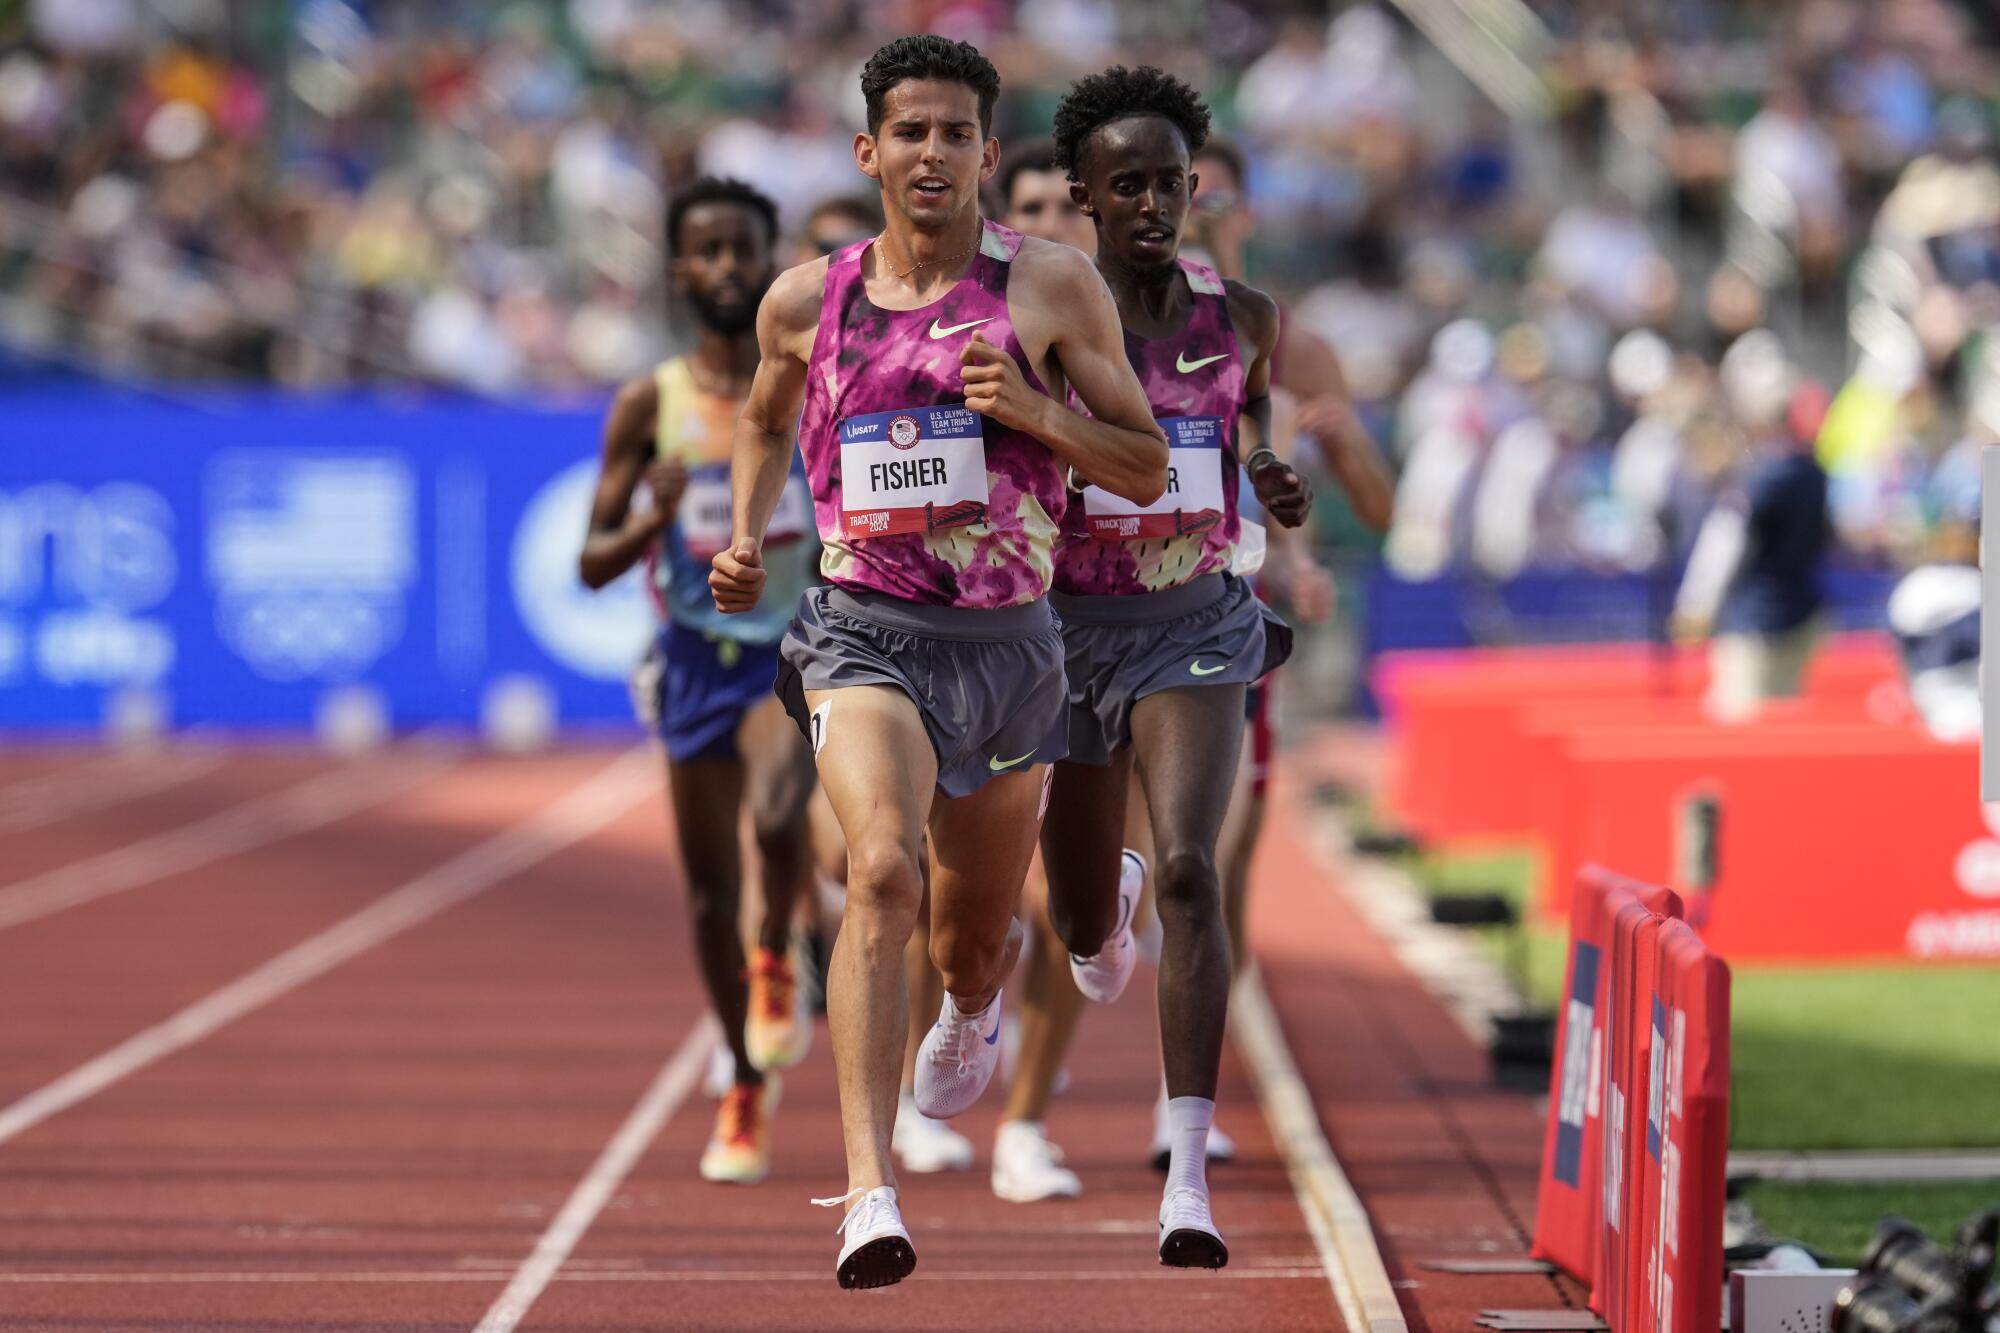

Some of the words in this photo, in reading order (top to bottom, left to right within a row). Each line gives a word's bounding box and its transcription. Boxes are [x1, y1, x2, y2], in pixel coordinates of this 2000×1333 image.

[930, 411, 942, 420] U.S.
[930, 420, 949, 429] TEAM
[950, 416, 974, 427] TRIALS
[854, 424, 879, 435] USATF
[870, 457, 947, 492] FISHER
[850, 511, 890, 527] TRACKTOWN
[869, 520, 889, 533] 2024
[1119, 526, 1139, 536] 2024
